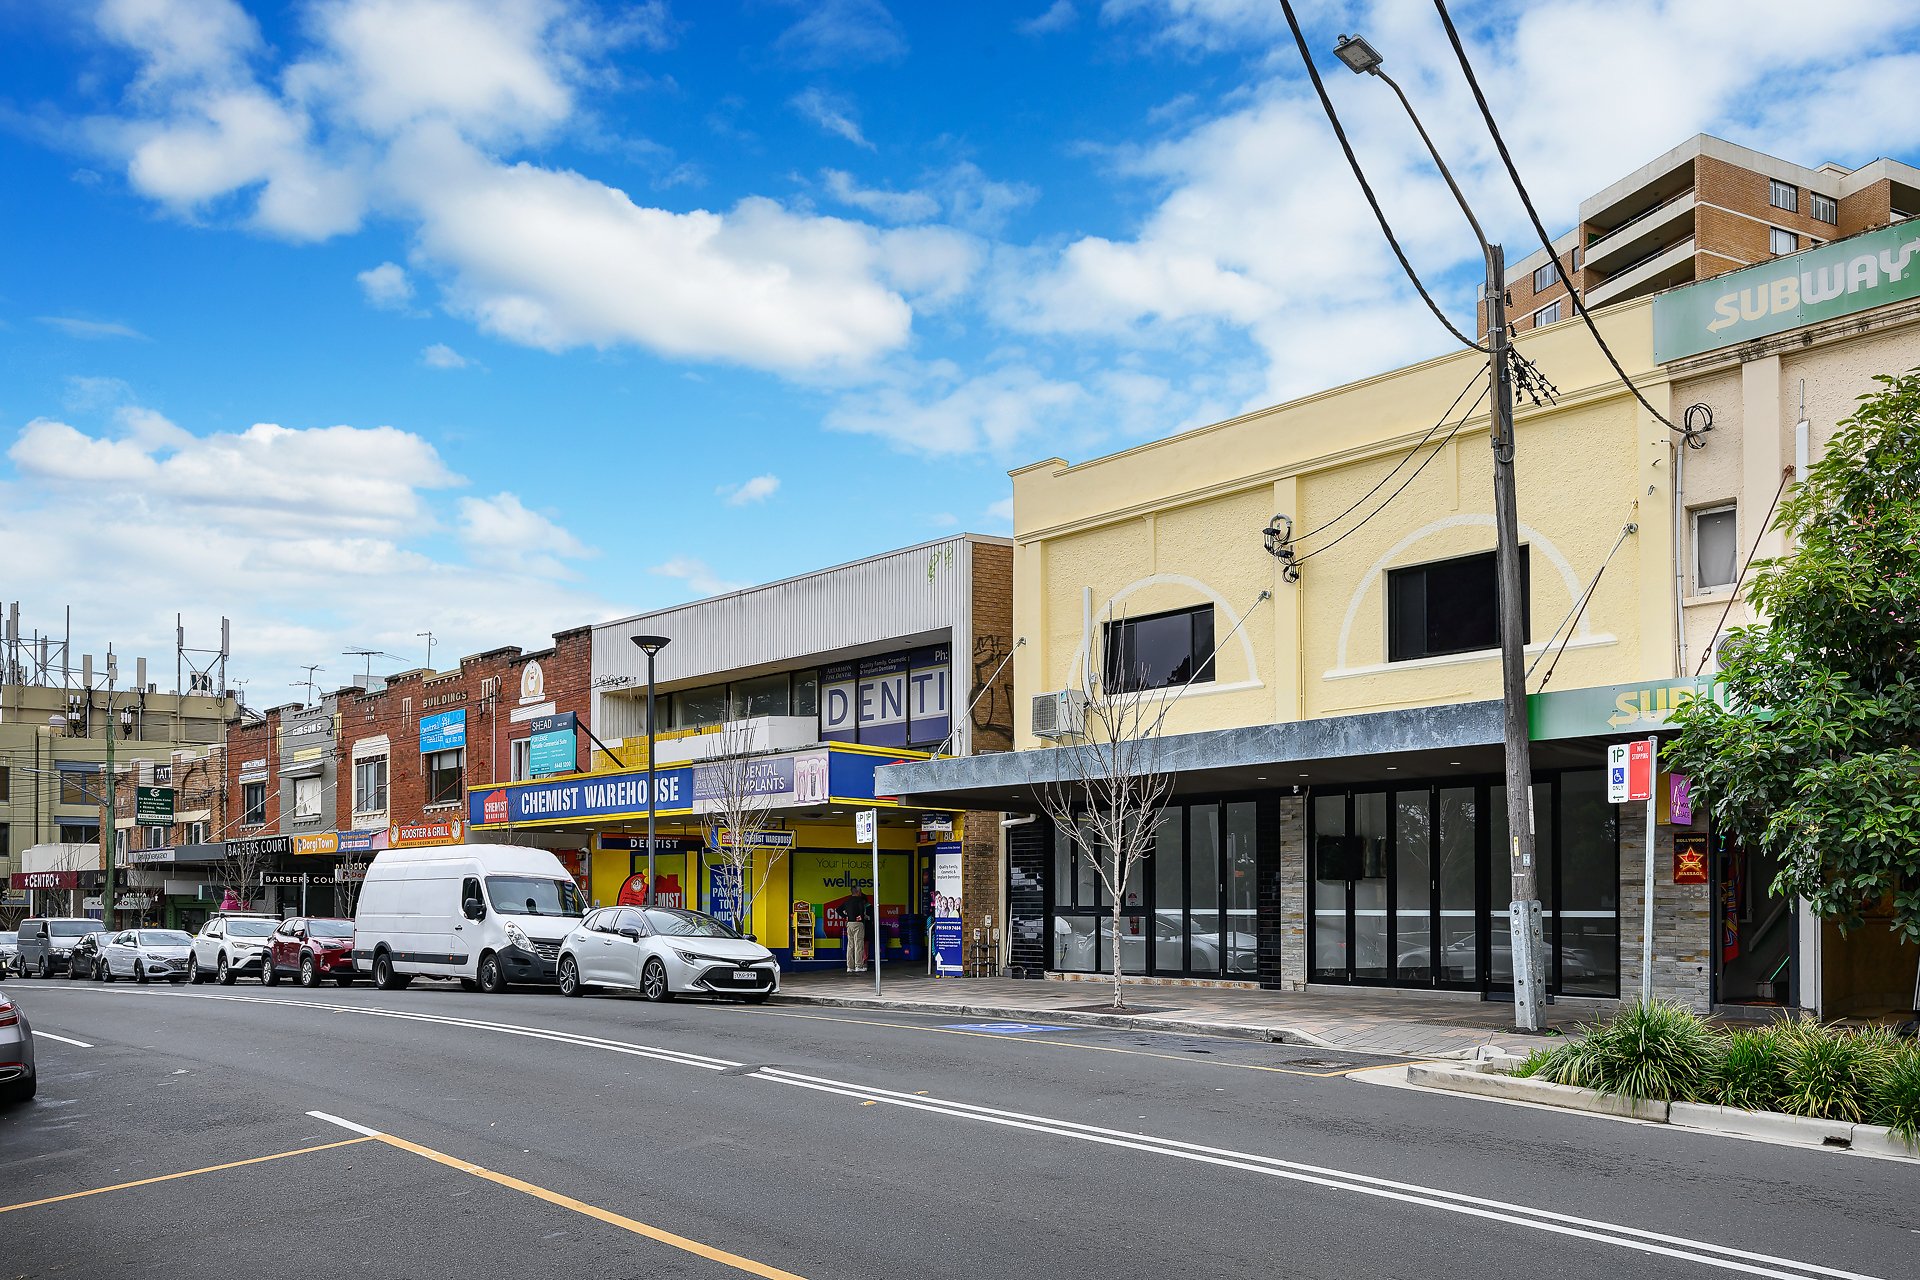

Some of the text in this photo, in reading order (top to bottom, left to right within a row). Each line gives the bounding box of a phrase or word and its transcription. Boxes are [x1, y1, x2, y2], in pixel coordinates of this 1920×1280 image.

[1706, 236, 1920, 334] SUBWAY
[934, 650, 948, 662] Ph:
[422, 693, 467, 708] BUILDINGS
[531, 719, 552, 732] SHEAD
[1612, 748, 1625, 763] 1P
[1631, 752, 1649, 760] STOPPING
[742, 777, 785, 792] MPLANTS
[485, 800, 507, 813] CHEMIST
[521, 787, 579, 815] CHEMIST
[401, 825, 449, 839] ROOSTER & GRILL
[260, 838, 287, 853] COURT
[318, 837, 334, 849] Town
[816, 858, 839, 868] Your
[29, 872, 55, 888] CENTRO
[265, 875, 310, 885] BARBERS
